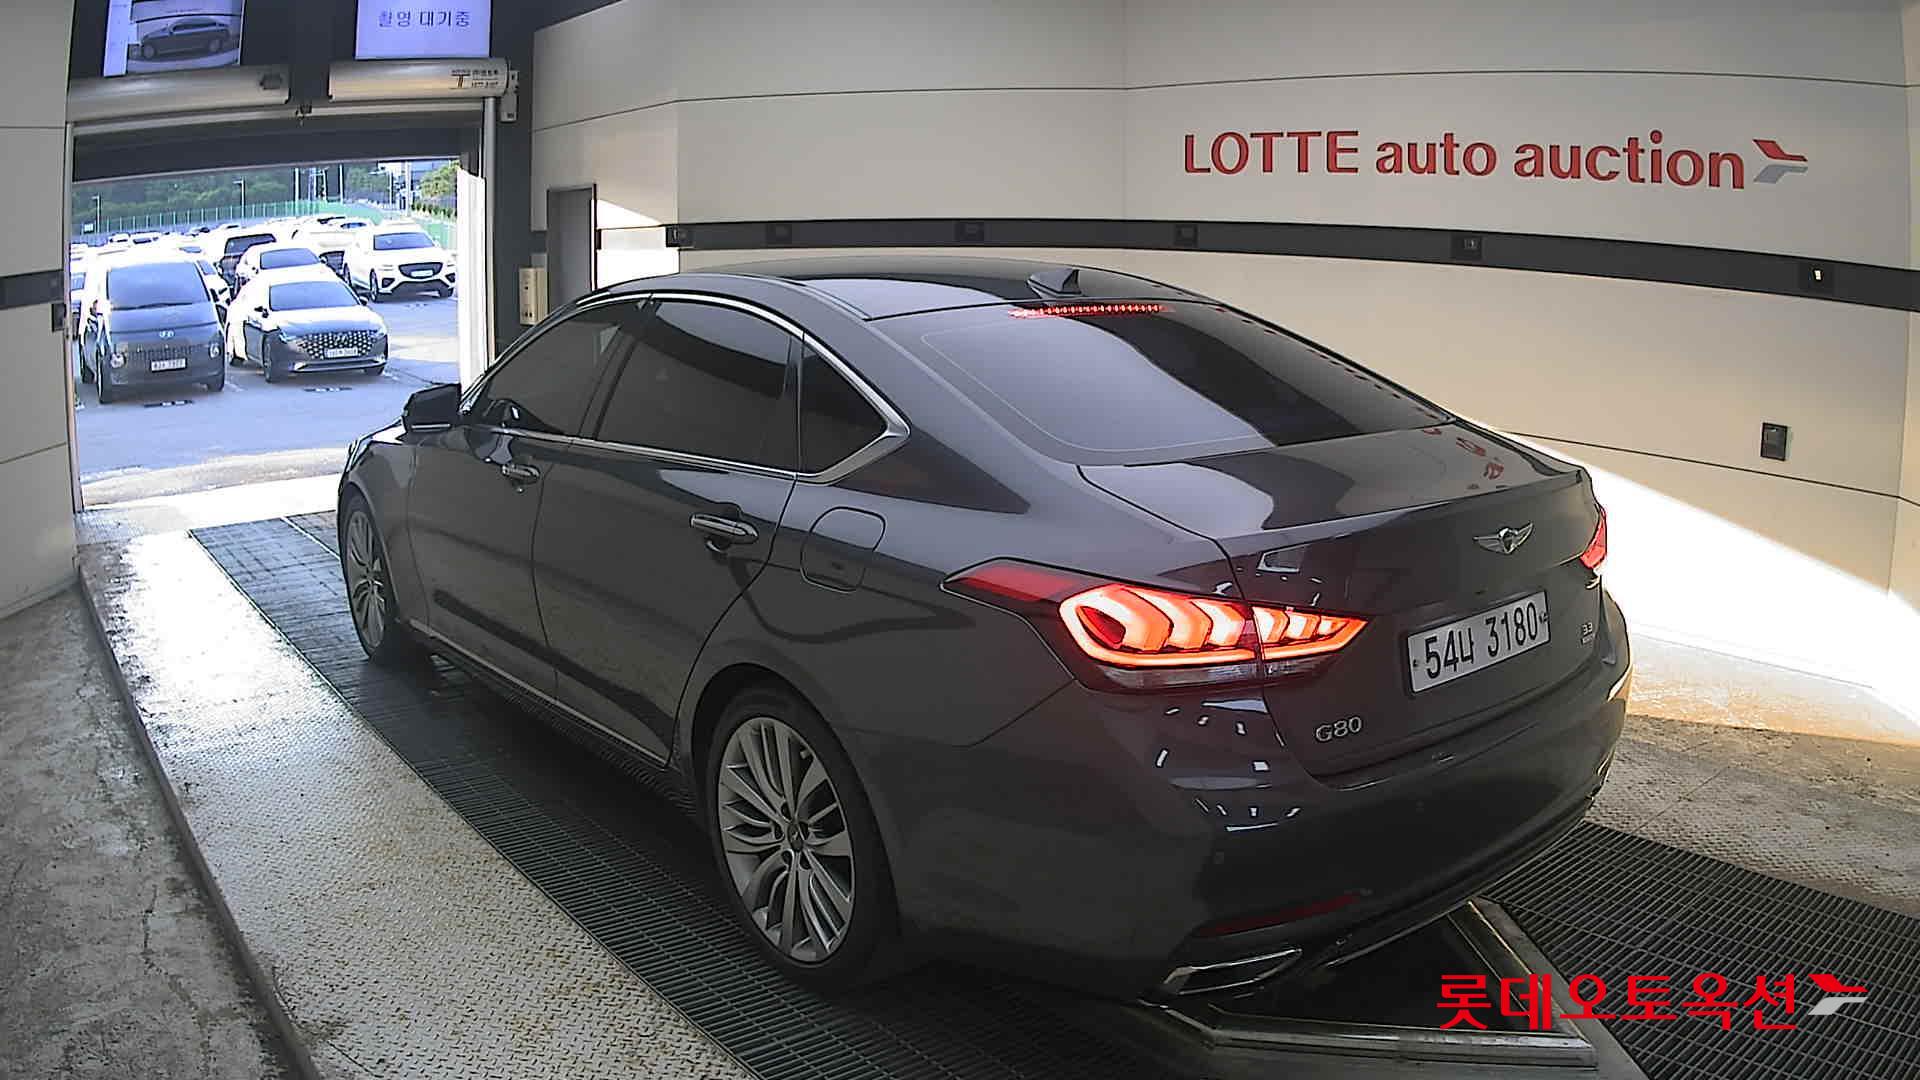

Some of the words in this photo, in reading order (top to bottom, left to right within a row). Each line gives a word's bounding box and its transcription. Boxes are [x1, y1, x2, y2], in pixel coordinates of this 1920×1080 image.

[419, 10, 470, 28] 대기중
[1184, 130, 1360, 175] LOTTE
[1375, 131, 1497, 177] auto
[1513, 130, 1746, 190] auction
[1424, 627, 1474, 679] 54나
[1485, 602, 1538, 657] 3180
[1315, 716, 1362, 742] G80
